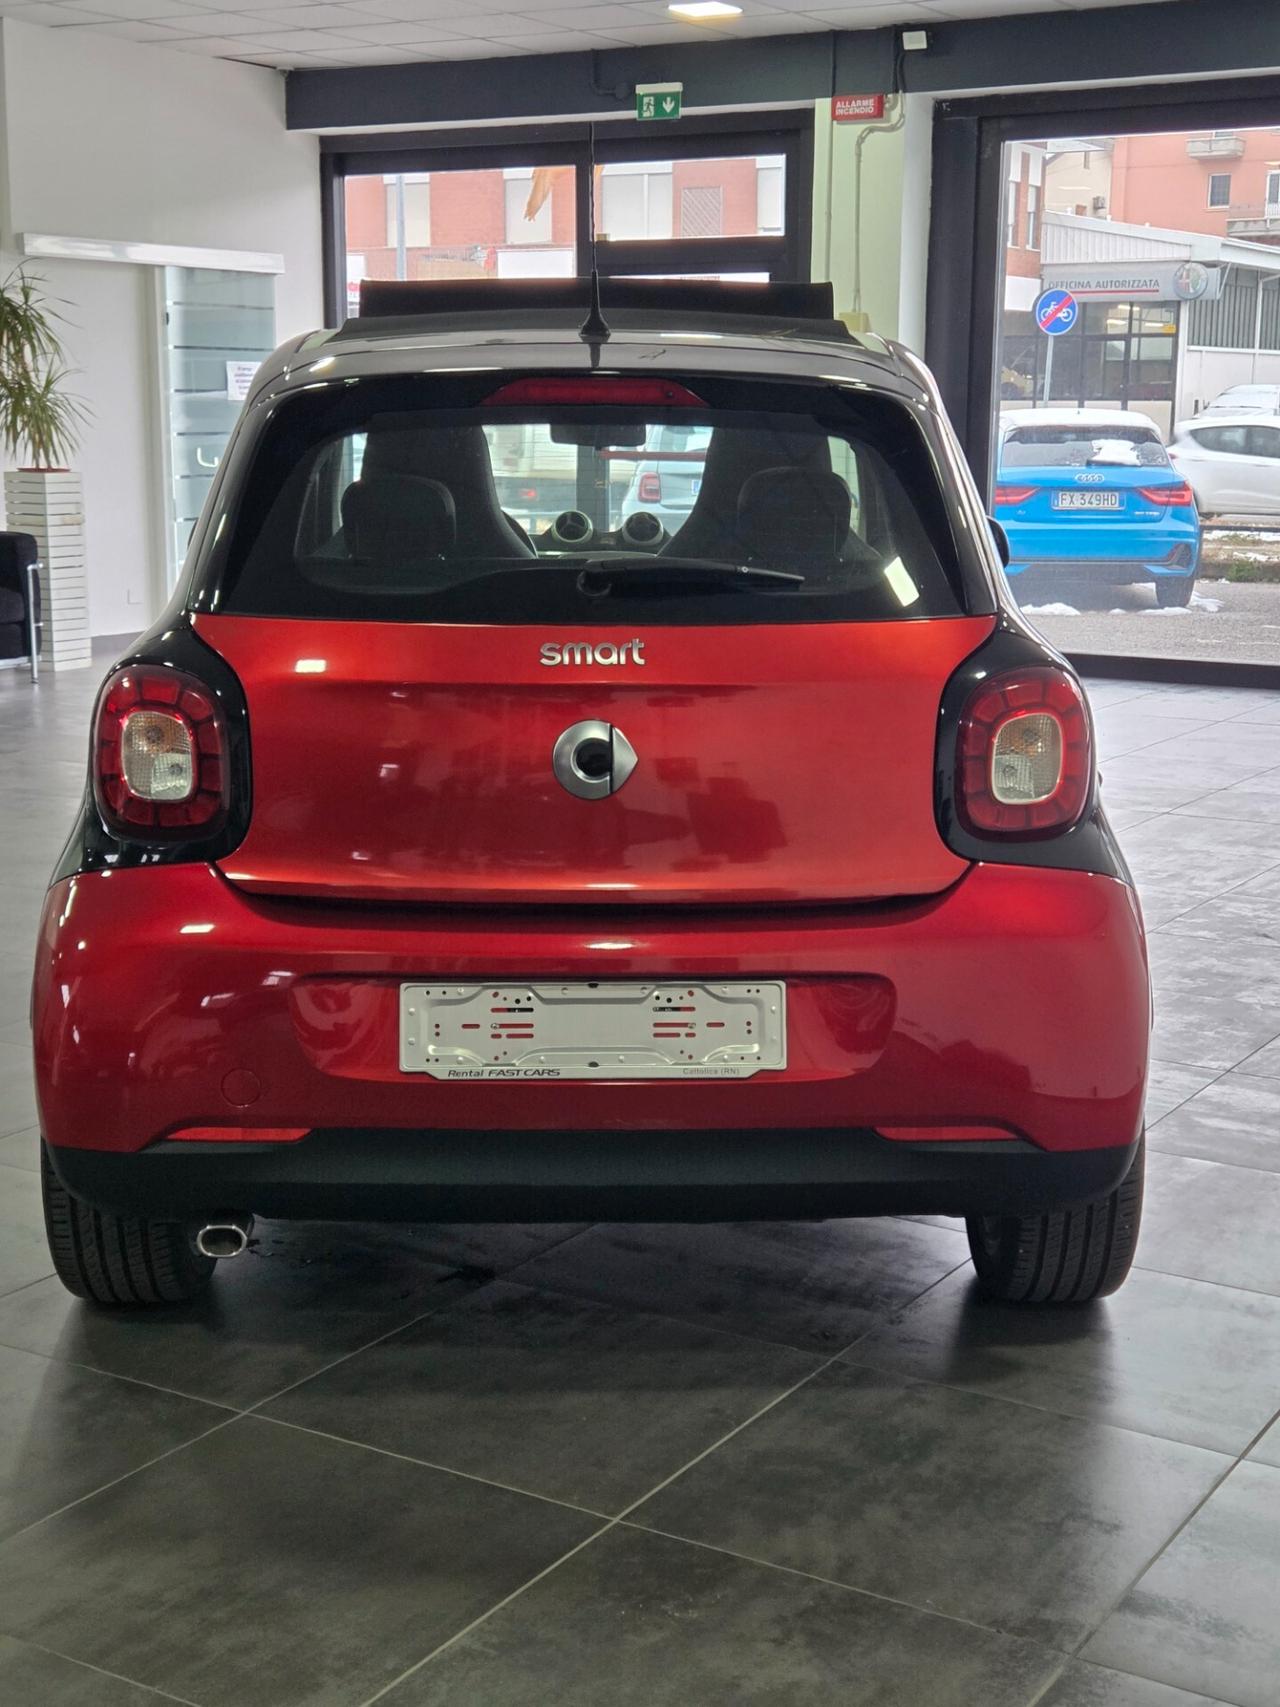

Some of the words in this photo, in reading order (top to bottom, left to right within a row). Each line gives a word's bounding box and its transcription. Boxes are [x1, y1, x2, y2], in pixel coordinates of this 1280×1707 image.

[835, 98, 875, 109] ALLARME
[835, 106, 874, 116] INCENDIO
[1048, 280, 1092, 290] OFFICINA
[1095, 278, 1161, 290] AUTORIZZATA
[540, 638, 646, 666] smart
[447, 1069, 485, 1078] Rental
[720, 1067, 741, 1076] (RN)
